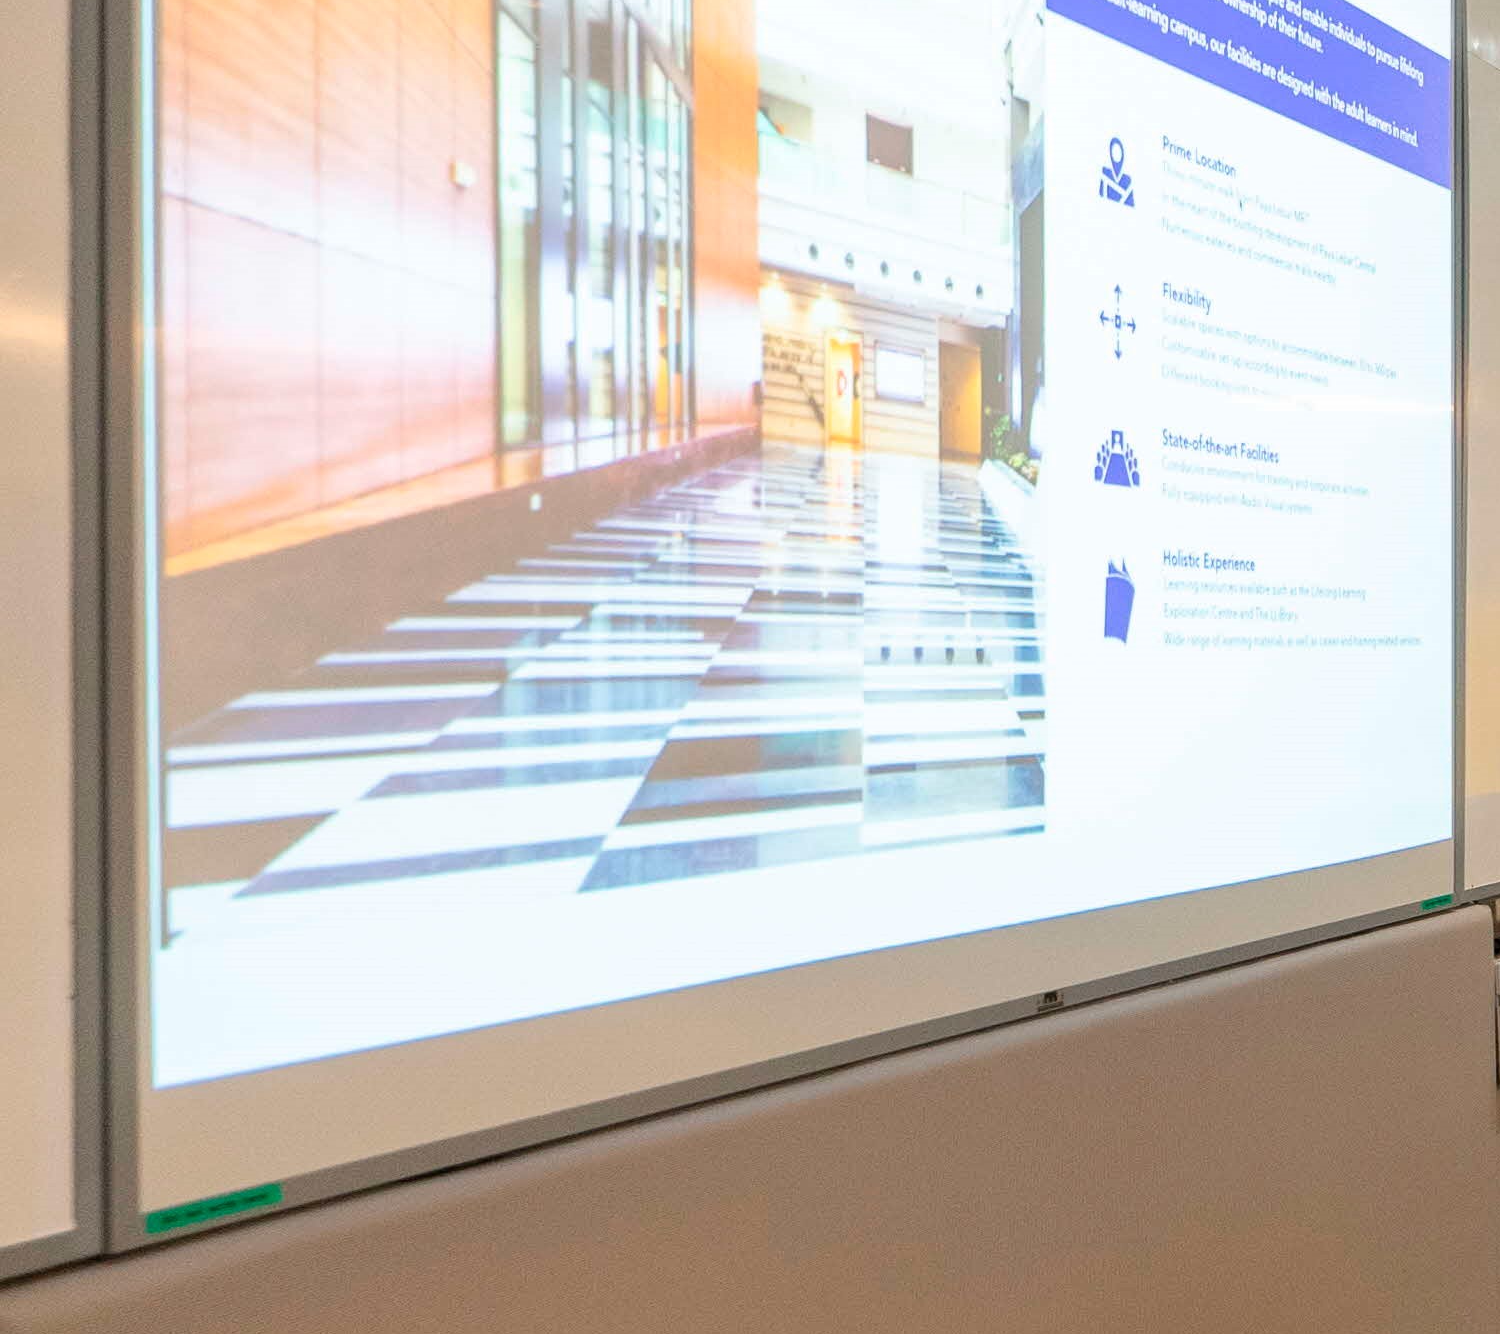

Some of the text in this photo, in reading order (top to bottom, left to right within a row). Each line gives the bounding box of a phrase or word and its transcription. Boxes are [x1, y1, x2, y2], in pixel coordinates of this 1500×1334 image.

[1267, 10, 1278, 30] of
[1278, 14, 1297, 40] their
[1297, 23, 1324, 54] future.
[1285, 0, 1302, 17] and
[1302, 7, 1329, 32] enable
[1329, 17, 1367, 53] individuals
[1367, 40, 1376, 58] to
[1376, 46, 1400, 70] pursue
[1400, 55, 1424, 88] lifelong
[1169, 18, 1209, 51] campus,
[1210, 38, 1226, 56] our
[1226, 39, 1262, 74] facilities
[1262, 63, 1277, 80] are
[1277, 65, 1315, 99] designed
[1314, 85, 1332, 107] with
[1332, 92, 1345, 113] the
[1345, 100, 1364, 123] adult
[1364, 105, 1393, 135] learners
[1392, 120, 1400, 139] in
[1162, 134, 1238, 179] Prime Location
[1162, 282, 1212, 316] Flexibility
[1162, 428, 1281, 464] State-of-the-art Facilities
[1163, 550, 1256, 574] Holistic Experience
